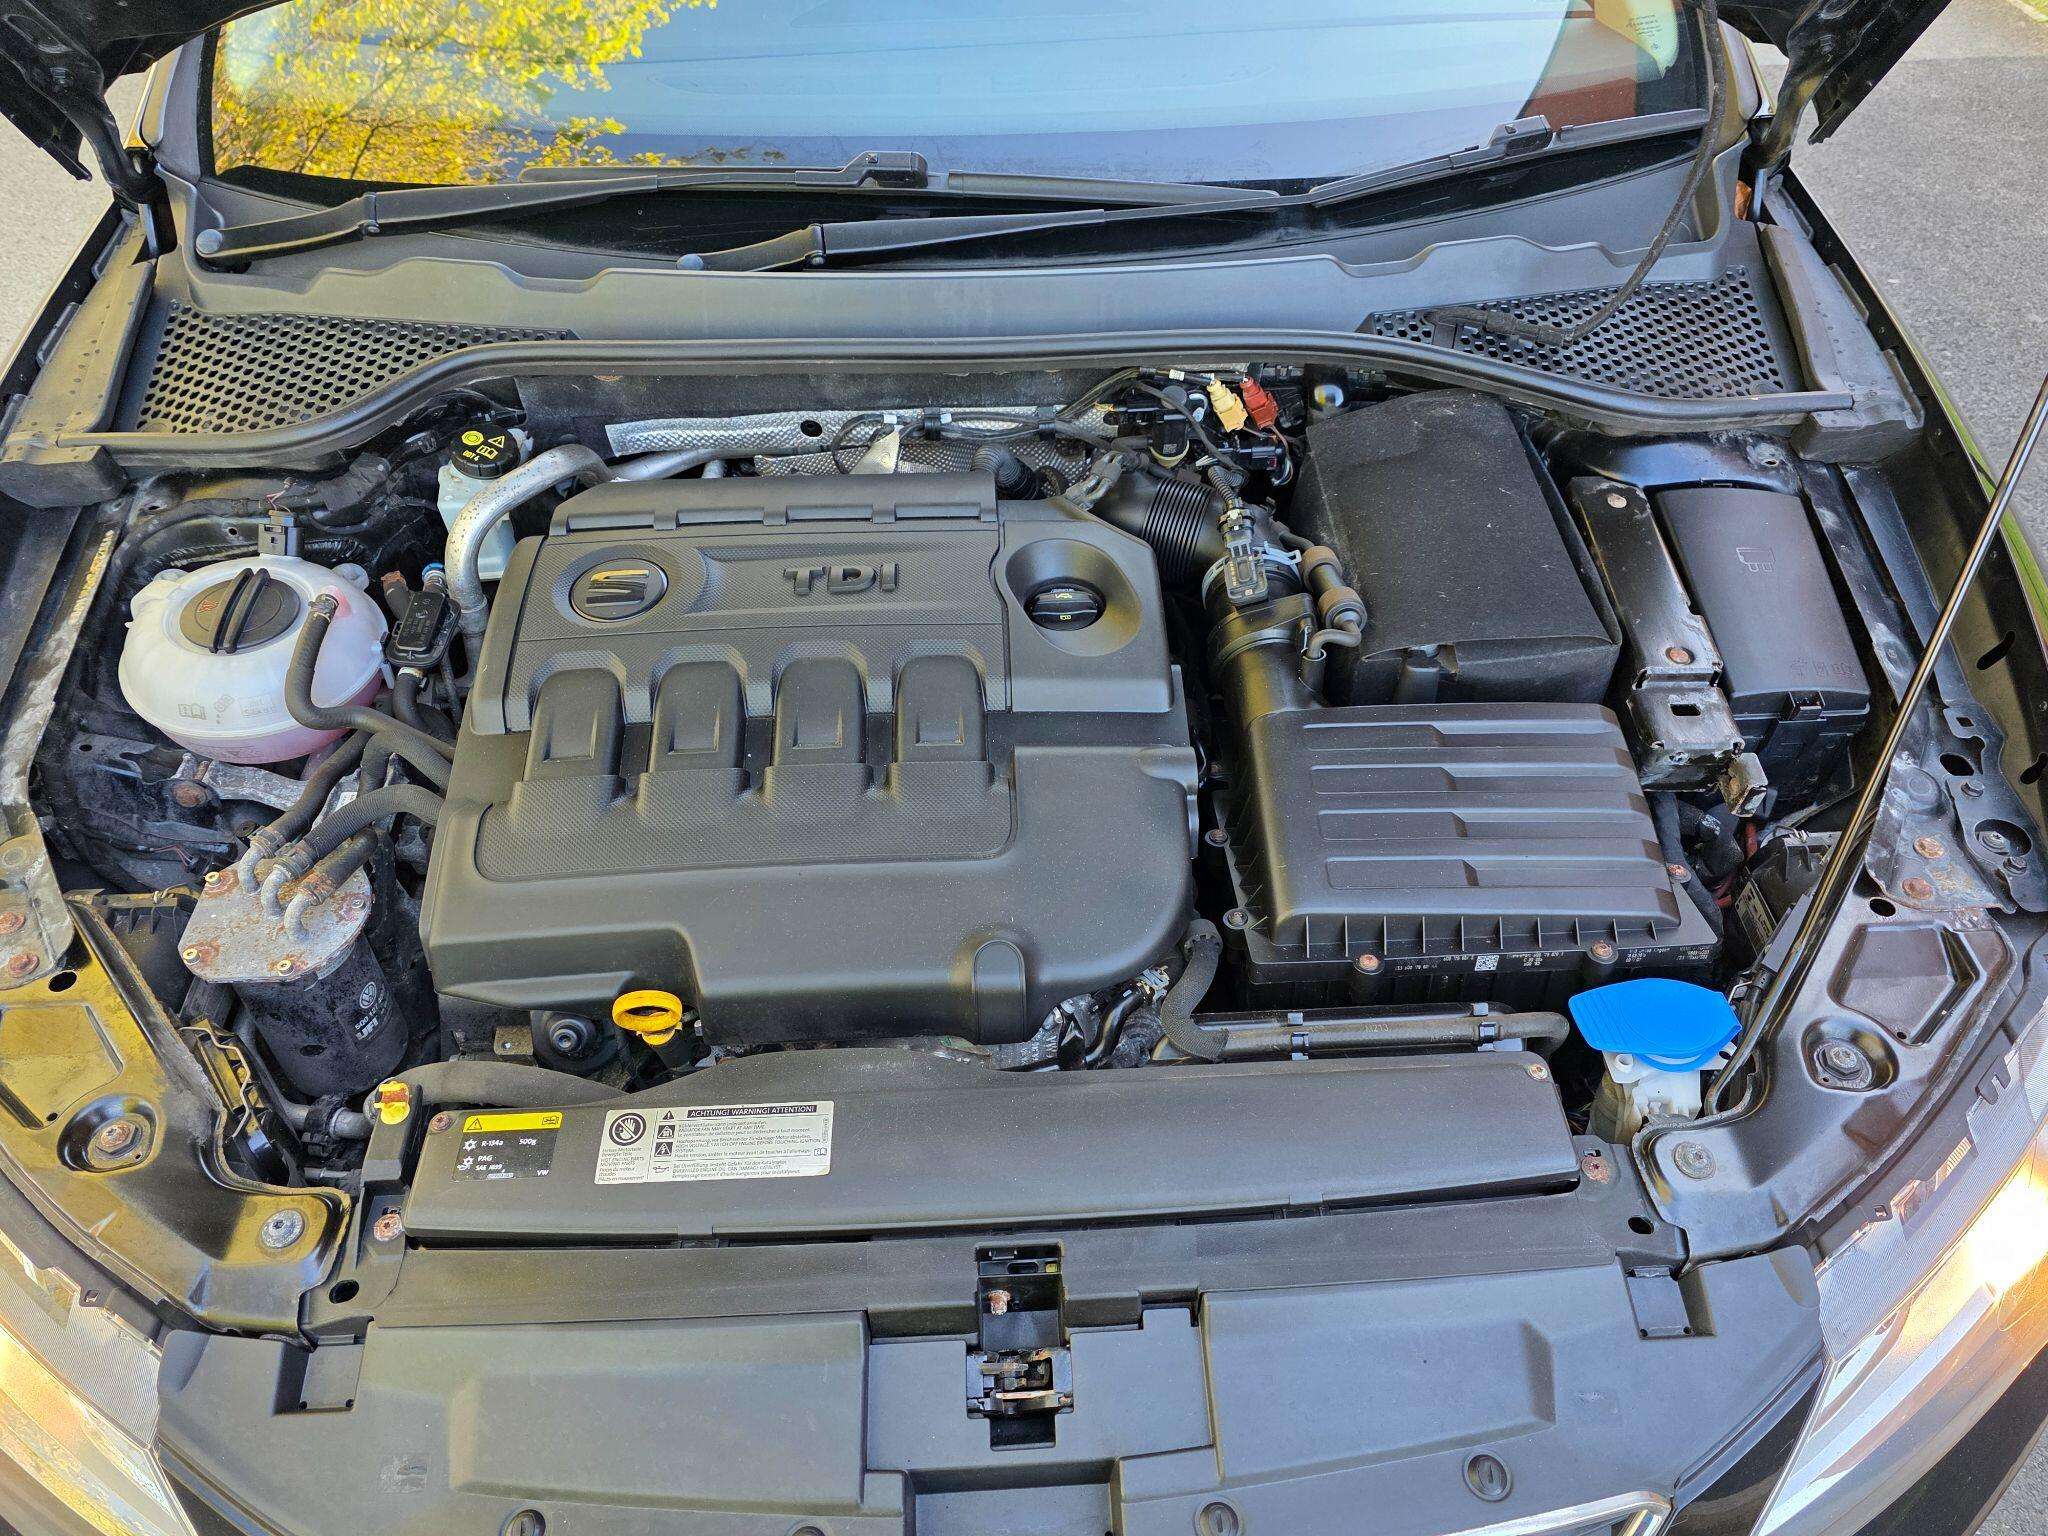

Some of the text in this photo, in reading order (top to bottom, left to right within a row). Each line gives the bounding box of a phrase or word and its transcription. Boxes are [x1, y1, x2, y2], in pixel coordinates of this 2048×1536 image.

[783, 563, 899, 595] TDI
[690, 1105, 815, 1117] ACHTUNG! WARNING! ATTENTION!
[518, 1138, 537, 1146] 500g
